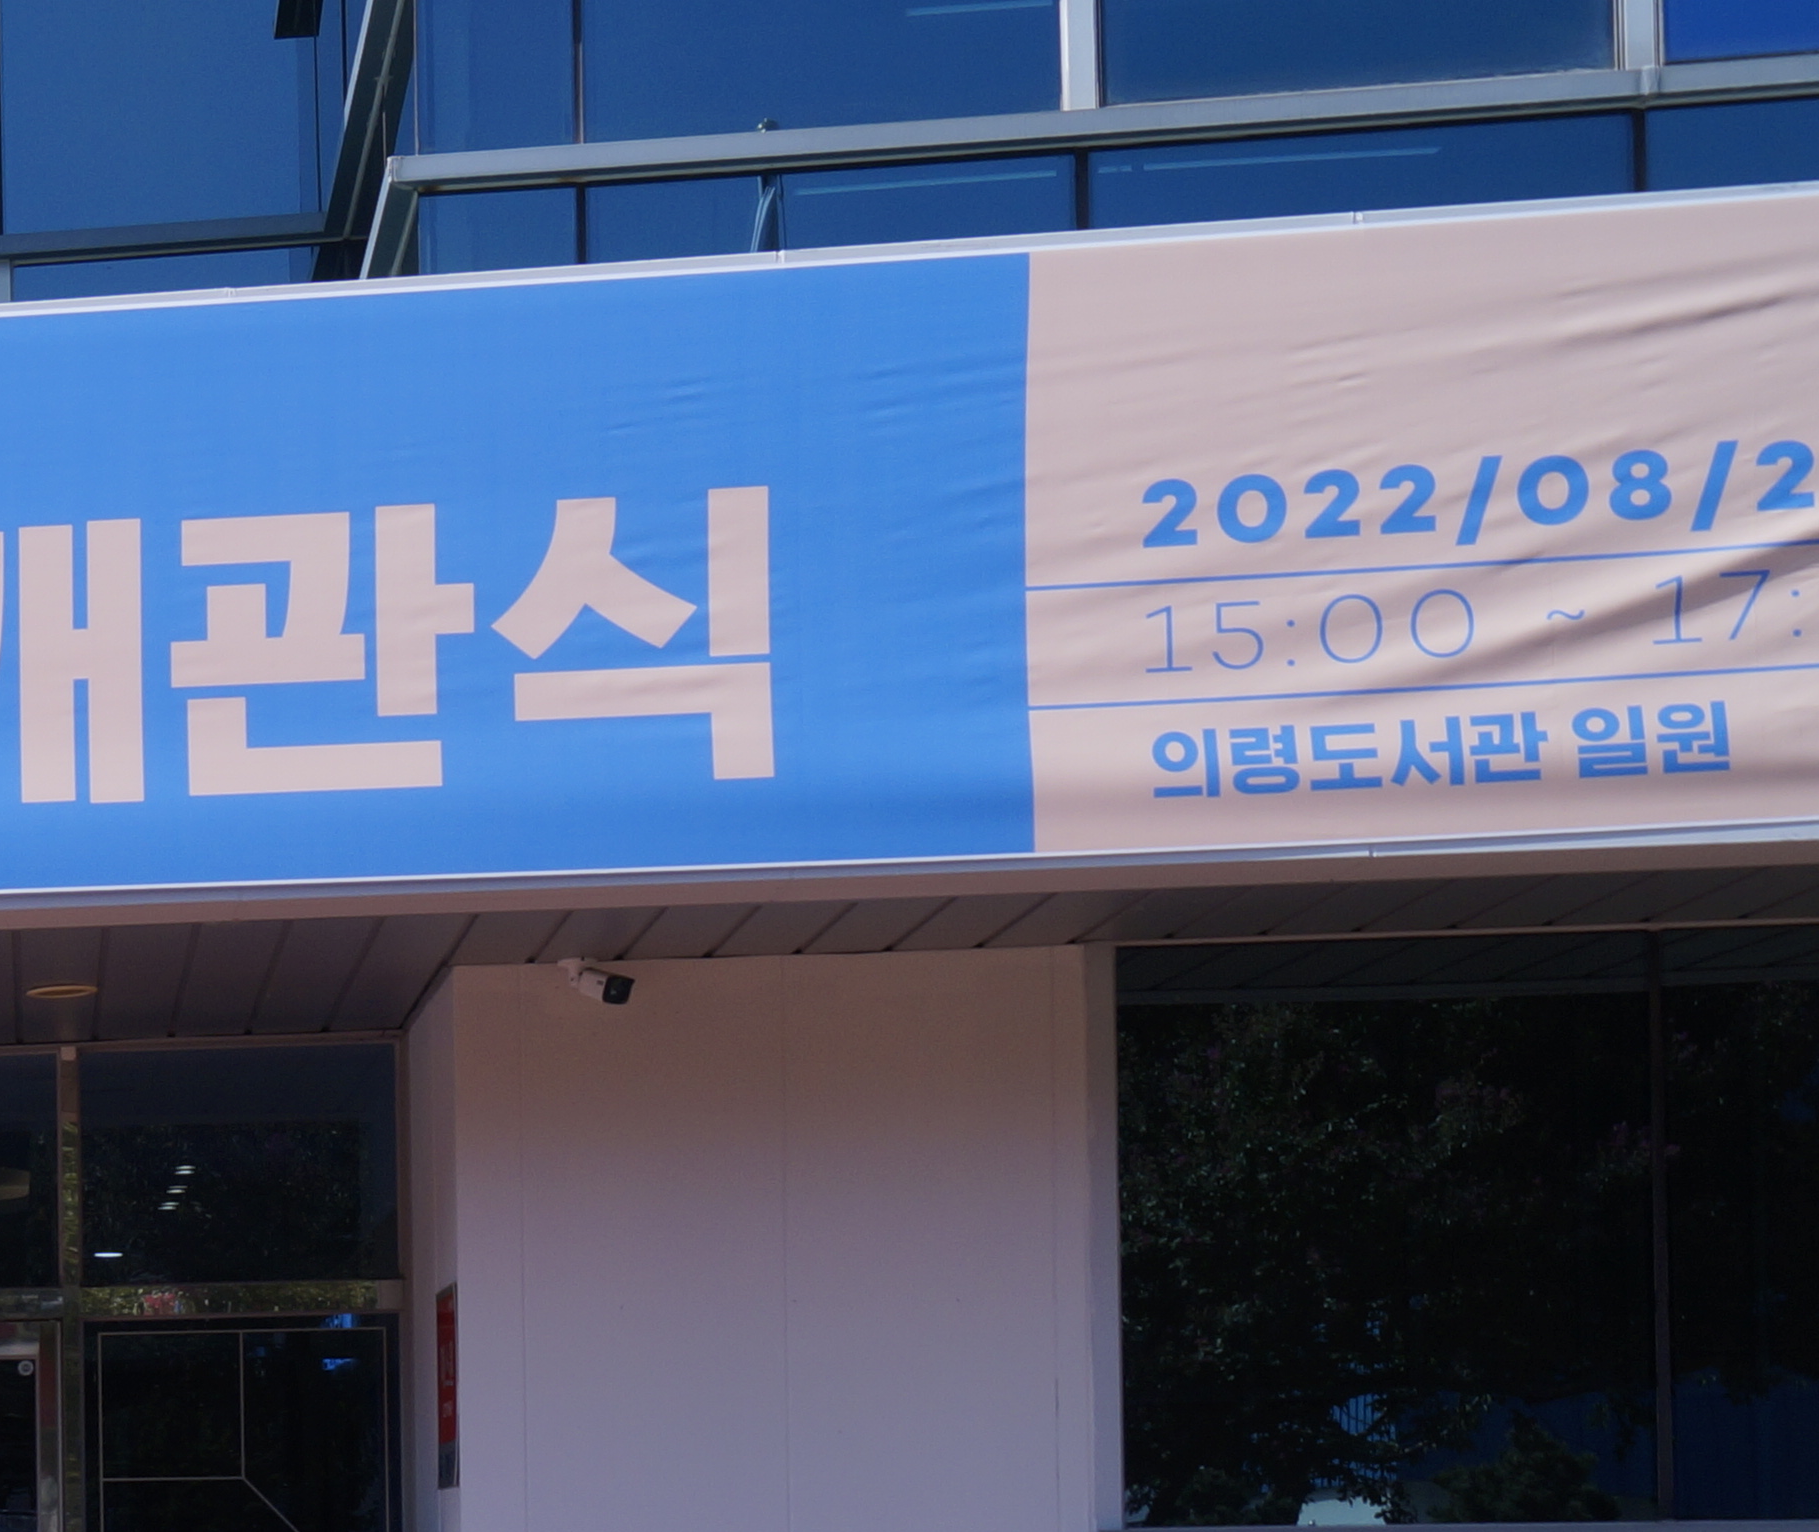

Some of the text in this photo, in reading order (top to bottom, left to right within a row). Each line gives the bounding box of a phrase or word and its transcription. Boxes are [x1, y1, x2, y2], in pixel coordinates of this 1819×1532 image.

[1144, 588, 1476, 675] 15:00
[1151, 700, 1731, 799] 의령도서관 일원
